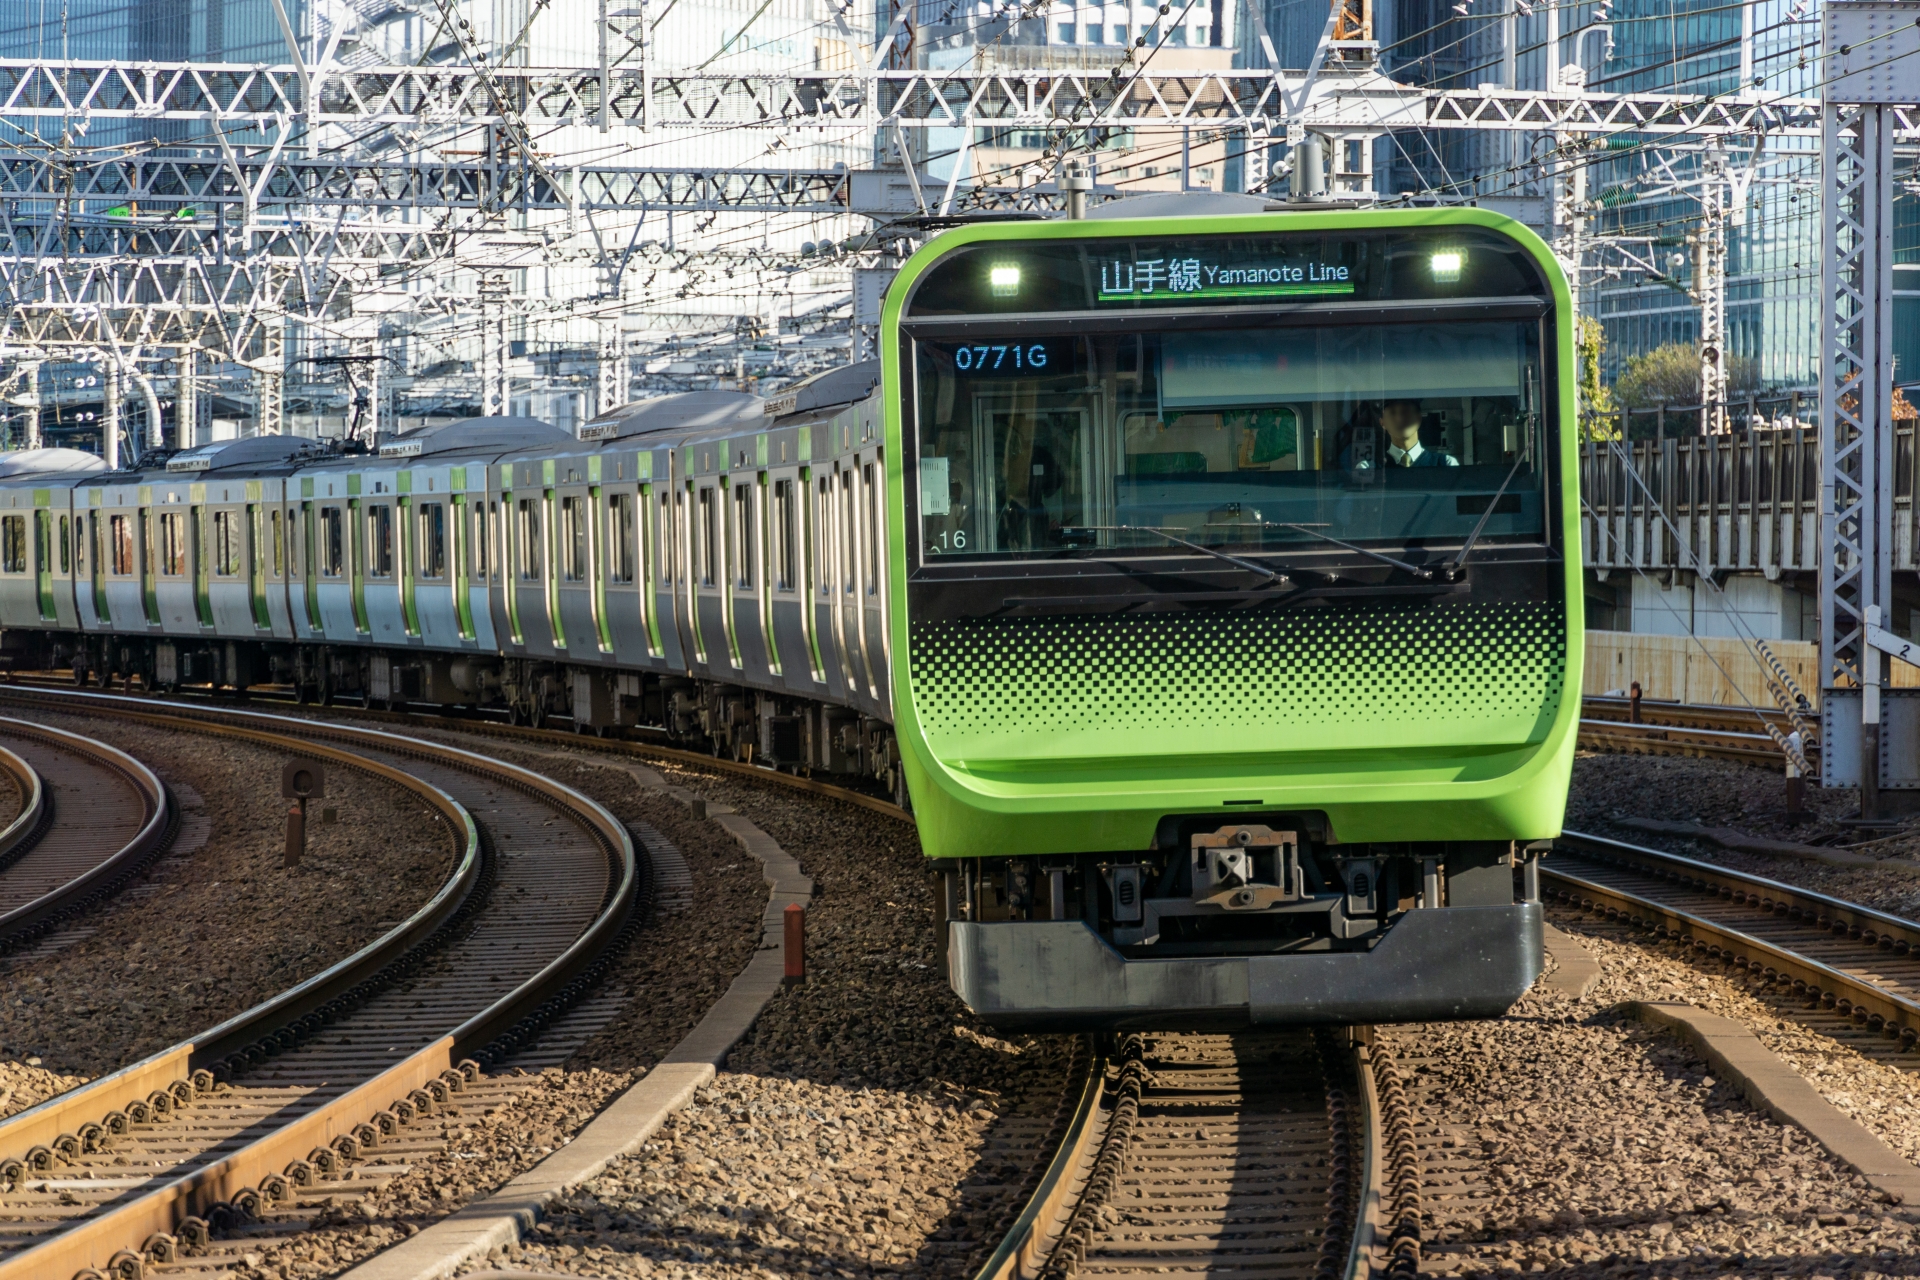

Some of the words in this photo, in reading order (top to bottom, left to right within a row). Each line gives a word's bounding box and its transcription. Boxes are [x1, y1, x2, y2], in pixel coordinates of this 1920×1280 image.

[1102, 258, 1202, 293] 山手線
[1204, 264, 1303, 285] Yamanote
[1309, 262, 1349, 282] Line
[956, 344, 1047, 370] 0771G
[940, 530, 966, 549] 16
[1900, 644, 1911, 659] 2
